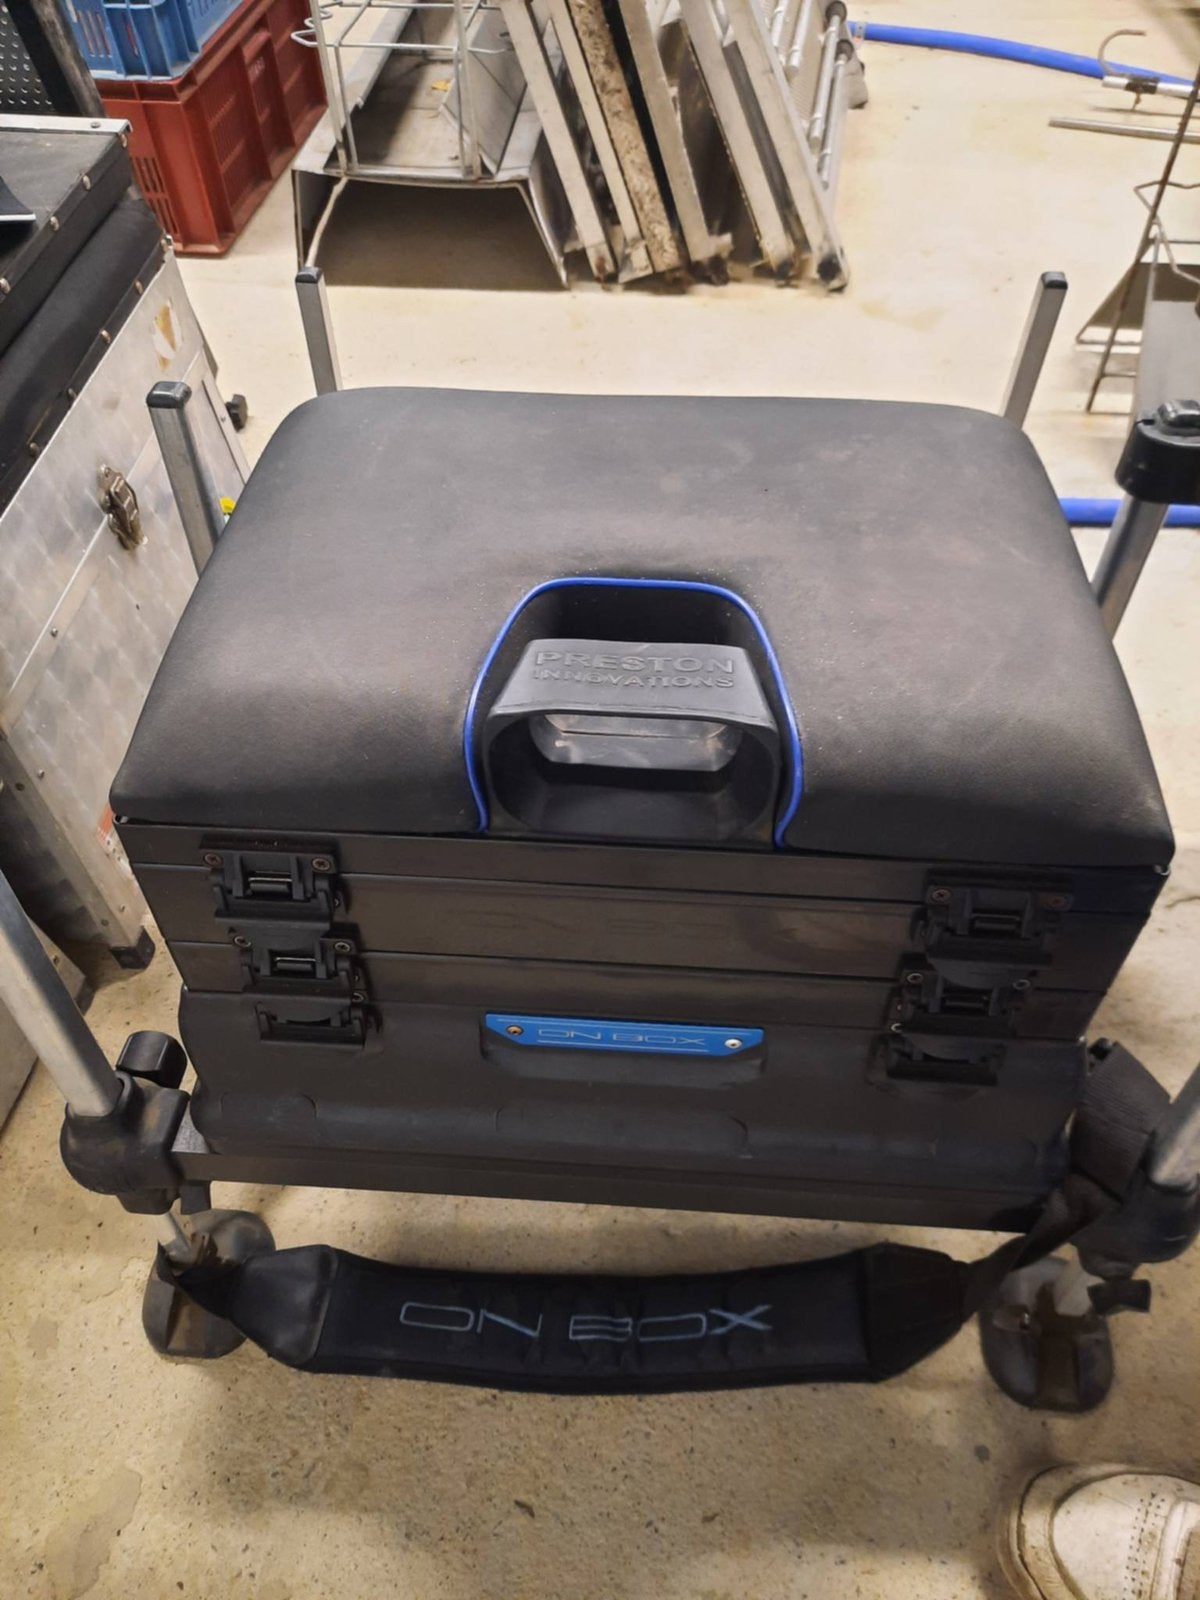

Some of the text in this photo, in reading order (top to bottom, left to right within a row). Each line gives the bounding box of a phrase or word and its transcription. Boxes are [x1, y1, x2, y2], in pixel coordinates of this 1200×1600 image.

[534, 651, 735, 674] PRESTON
[532, 670, 735, 688] INNOVATIONS
[538, 1029, 705, 1045] ON BOX
[400, 1302, 772, 1342] ON BOX
